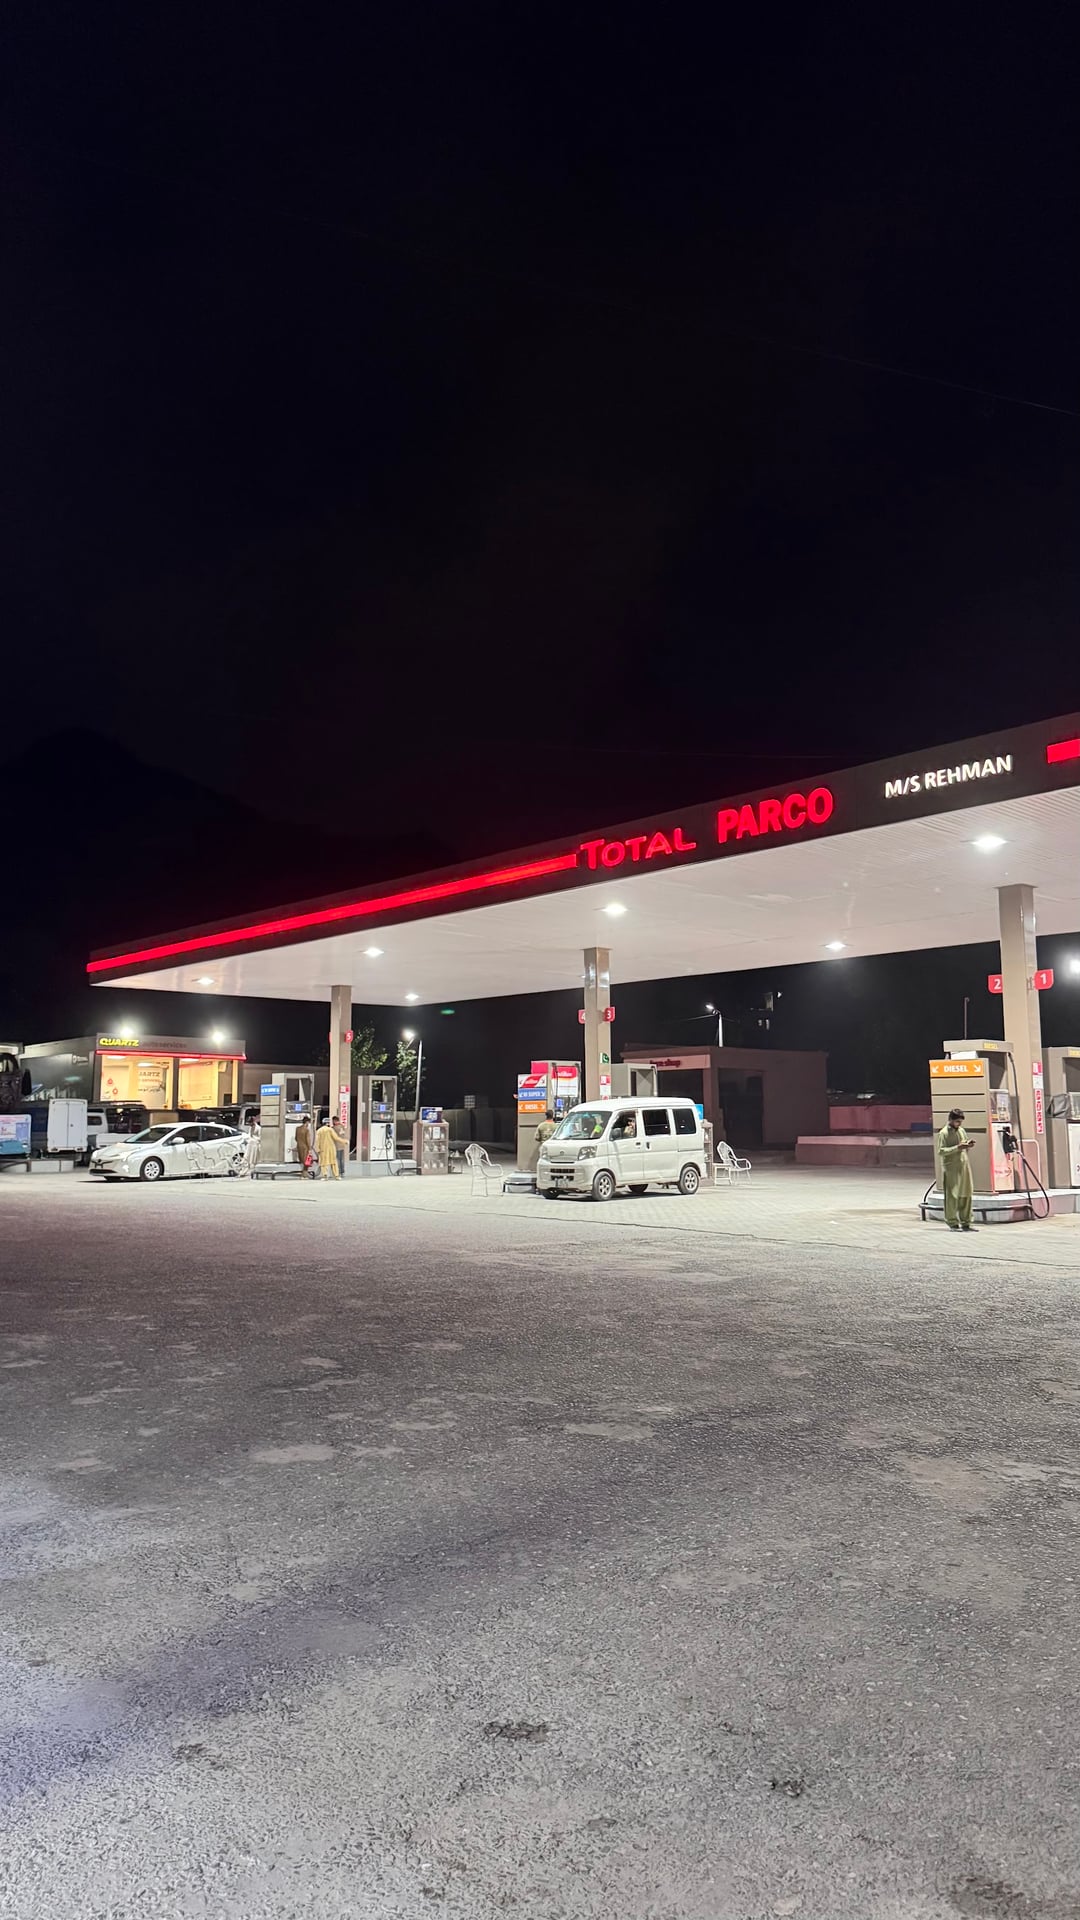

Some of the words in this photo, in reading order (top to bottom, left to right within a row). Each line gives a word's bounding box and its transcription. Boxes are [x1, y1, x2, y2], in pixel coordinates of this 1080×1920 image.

[885, 775, 921, 798] M/S
[925, 754, 1013, 789] REHMAN
[580, 828, 697, 870] TOTAL
[717, 787, 834, 844] PARCO
[993, 978, 1001, 990] 2
[1039, 972, 1047, 985] 1
[606, 1010, 612, 1019] 3
[99, 1038, 139, 1047] QUARTZ
[943, 1064, 969, 1073] DIESEL
